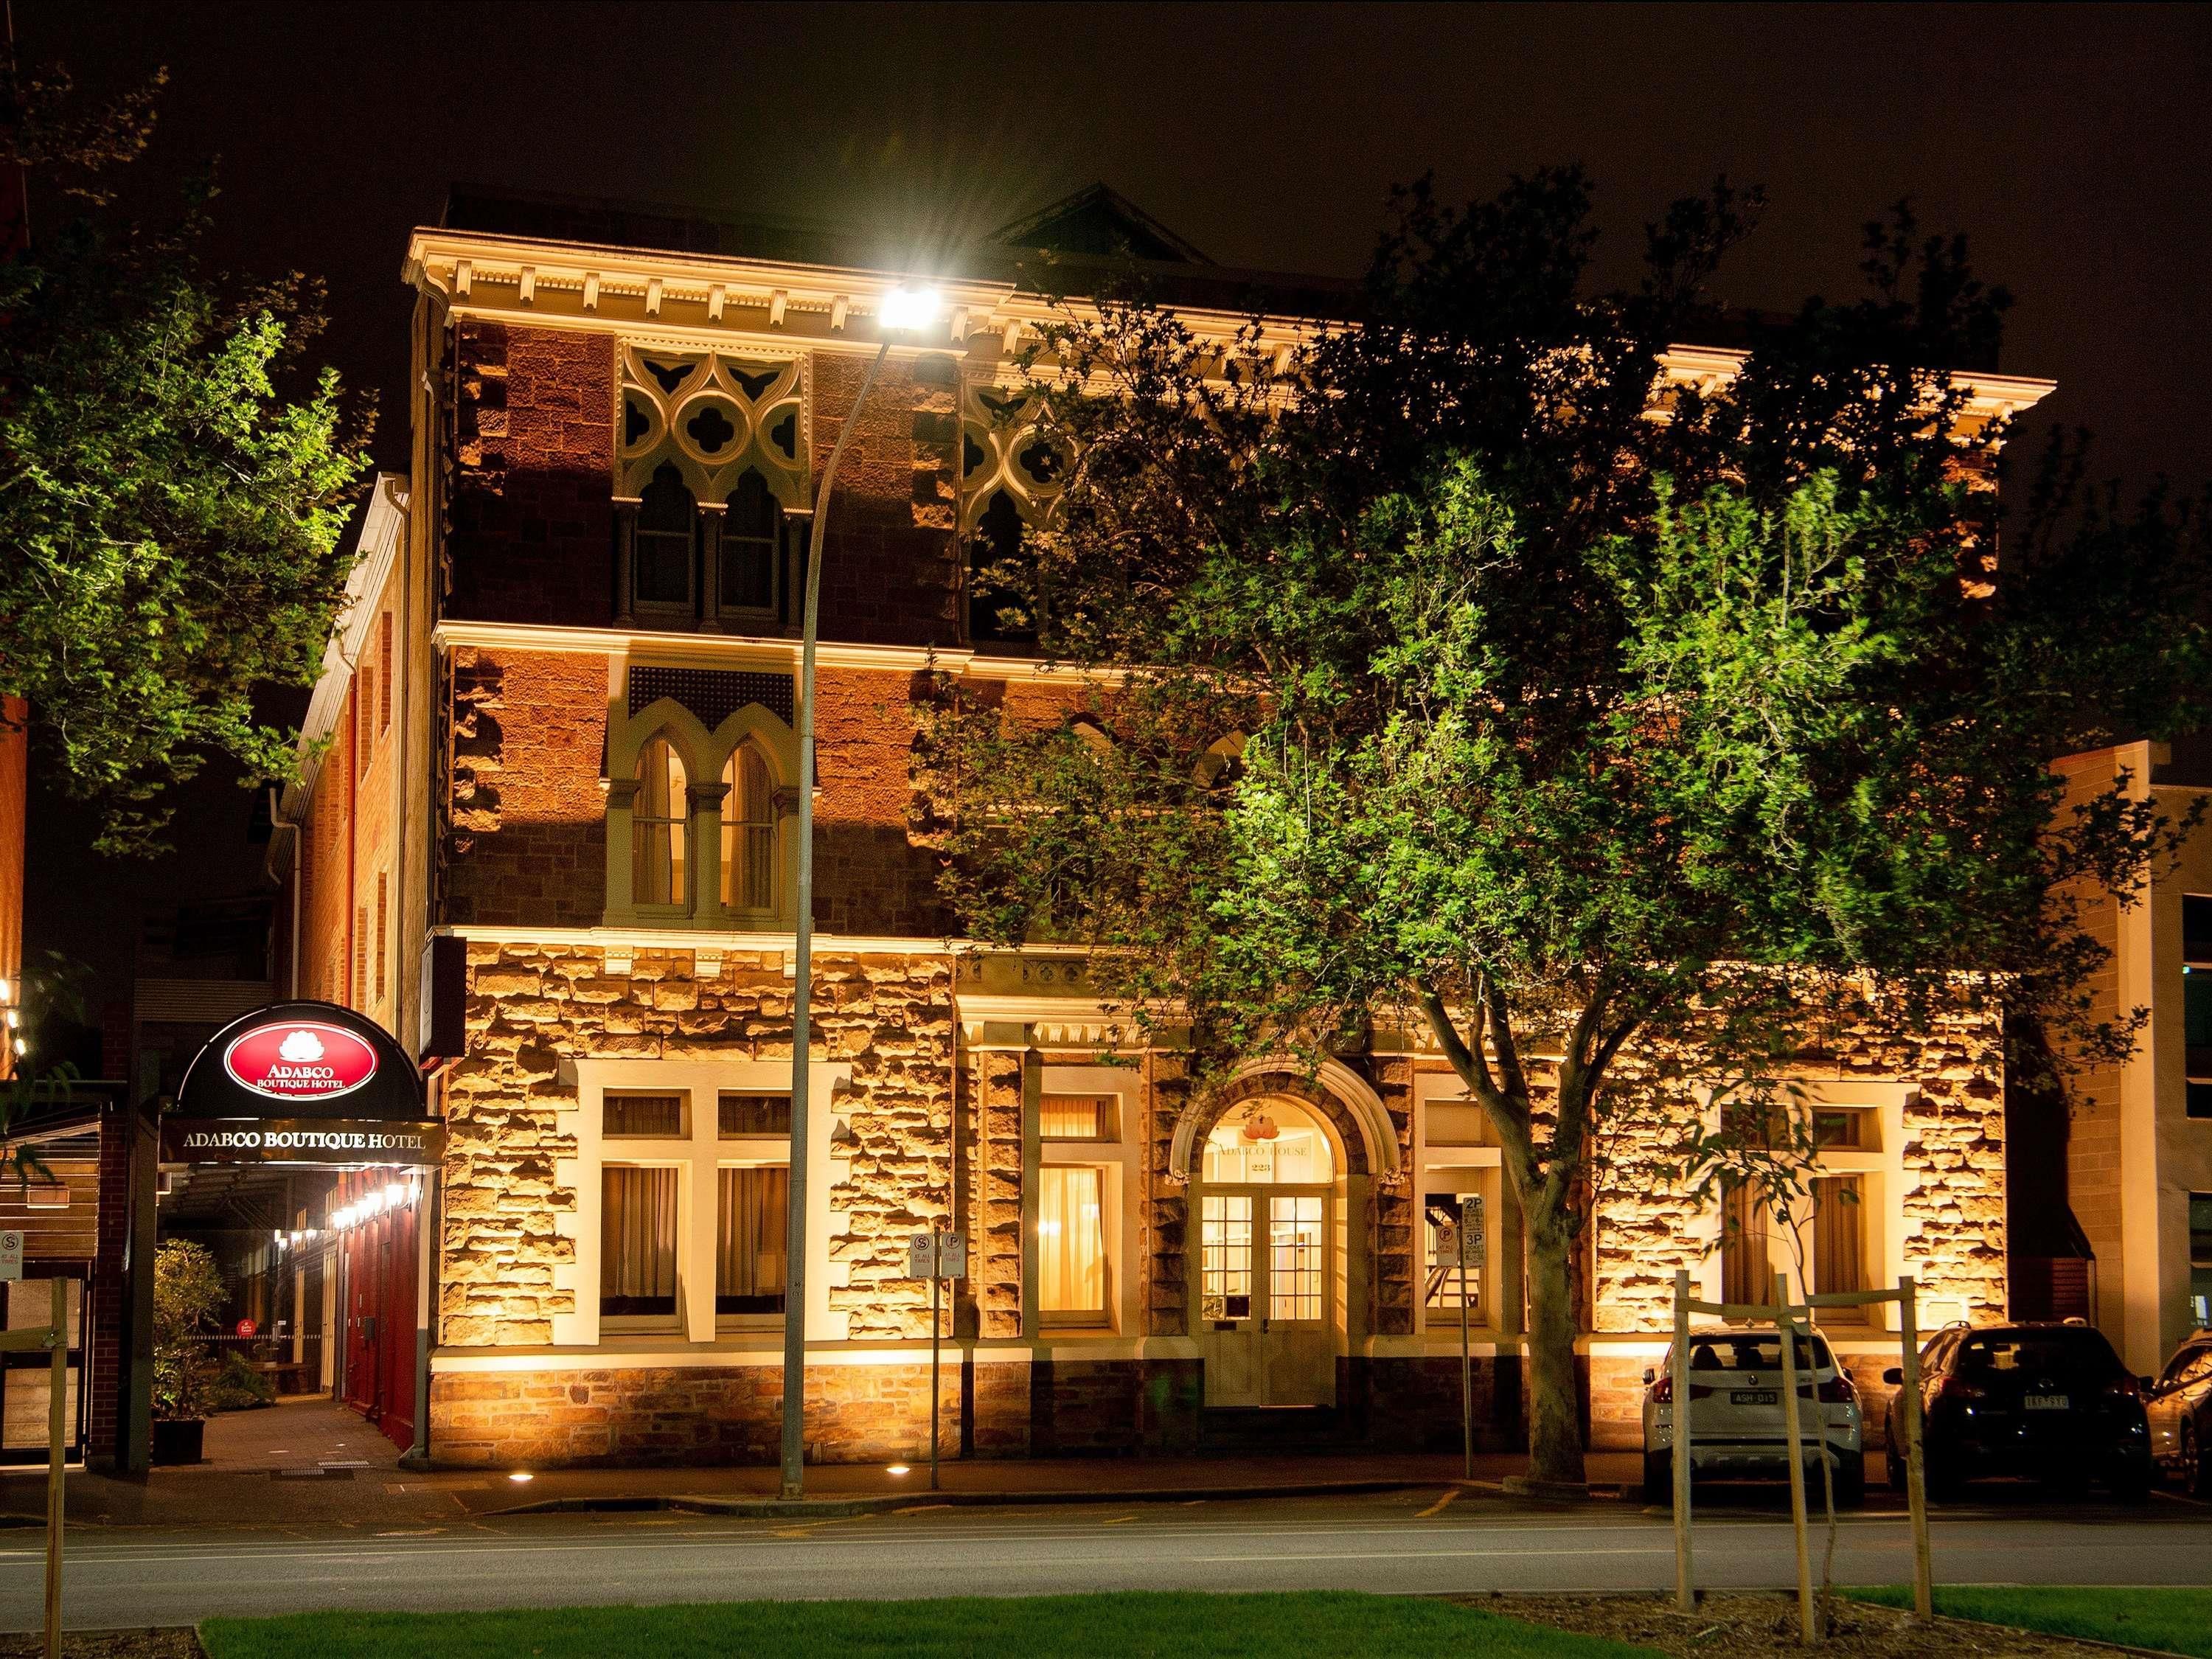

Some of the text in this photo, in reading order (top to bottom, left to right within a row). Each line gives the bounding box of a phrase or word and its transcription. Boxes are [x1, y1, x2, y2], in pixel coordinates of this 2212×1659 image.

[267, 1064, 334, 1079] ADABCO
[257, 1079, 346, 1089] BOUTIQUE HOTEL
[184, 1132, 426, 1150] ADABCO BOUTIQUE HOTEL
[1216, 1144, 1265, 1156] ADABCO
[1251, 1164, 1270, 1172] 223
[1466, 1198, 1482, 1209] 2P
[1467, 1234, 1482, 1245] 3P
